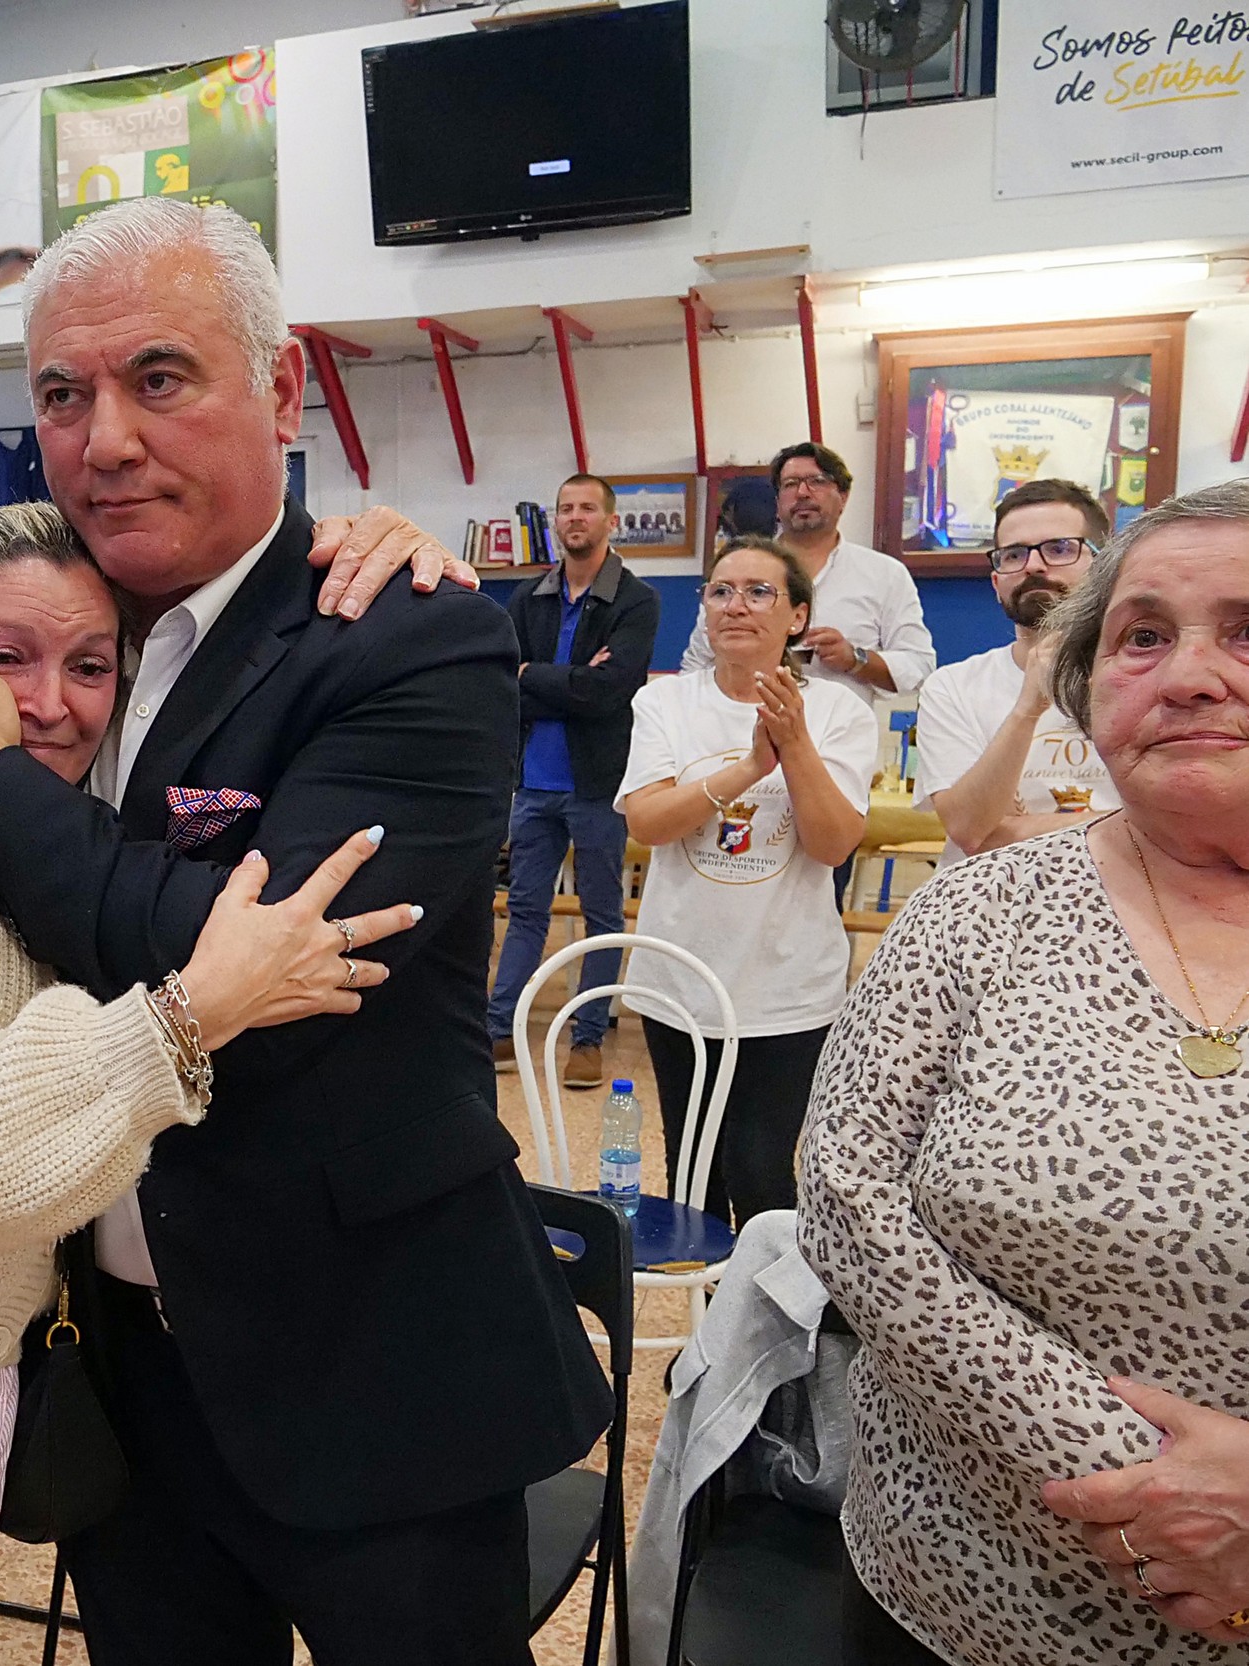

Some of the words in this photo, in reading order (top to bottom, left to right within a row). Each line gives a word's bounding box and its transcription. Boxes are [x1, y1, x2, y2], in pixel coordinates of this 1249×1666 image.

[1033, 25, 1157, 70] Somos
[1055, 71, 1096, 105] de
[1103, 51, 1246, 105] Setúbal
[1070, 145, 1224, 169] www.secil-group.com
[955, 407, 992, 427] GRUPO
[994, 404, 1027, 414] CORAL
[1030, 404, 1093, 430] ALENTEJANO
[1044, 738, 1088, 766] 70
[1023, 765, 1109, 779] aniversári
[693, 849, 719, 860] GRUPO
[722, 854, 777, 866] DESPORTIVO
[698, 858, 767, 873] INDEPENDENTE
